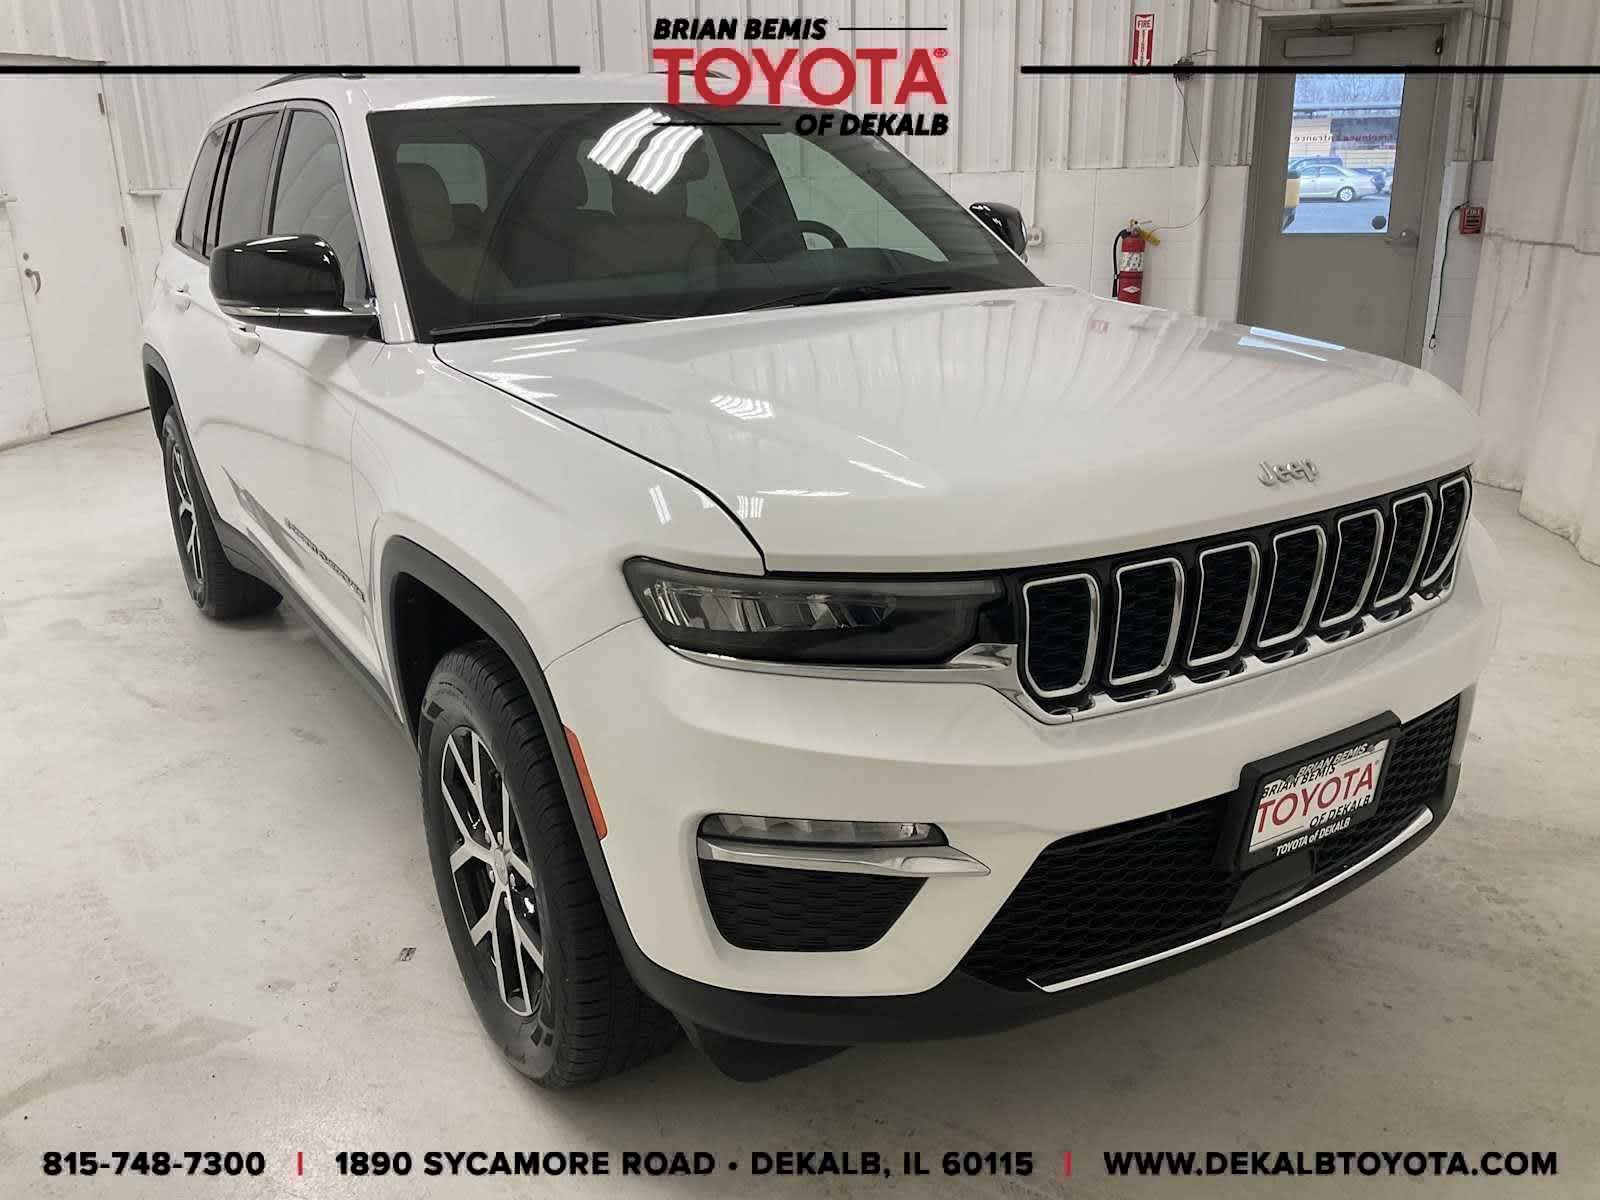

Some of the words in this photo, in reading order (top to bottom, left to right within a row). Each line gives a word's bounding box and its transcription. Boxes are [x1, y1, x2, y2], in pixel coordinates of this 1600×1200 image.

[1137, 20, 1151, 29] FIRE
[1257, 458, 1319, 487] Jeep
[1296, 755, 1335, 777] BRIAN
[1333, 743, 1368, 764] BEMIS
[1300, 765, 1336, 785] BEMIS
[1257, 763, 1373, 833] TOYOTA
[1309, 814, 1328, 829] OF
[1327, 794, 1371, 821] DEKALB
[1275, 835, 1308, 857] TOYOTA
[1308, 831, 1319, 844] of
[1318, 817, 1351, 840] DEKALB
